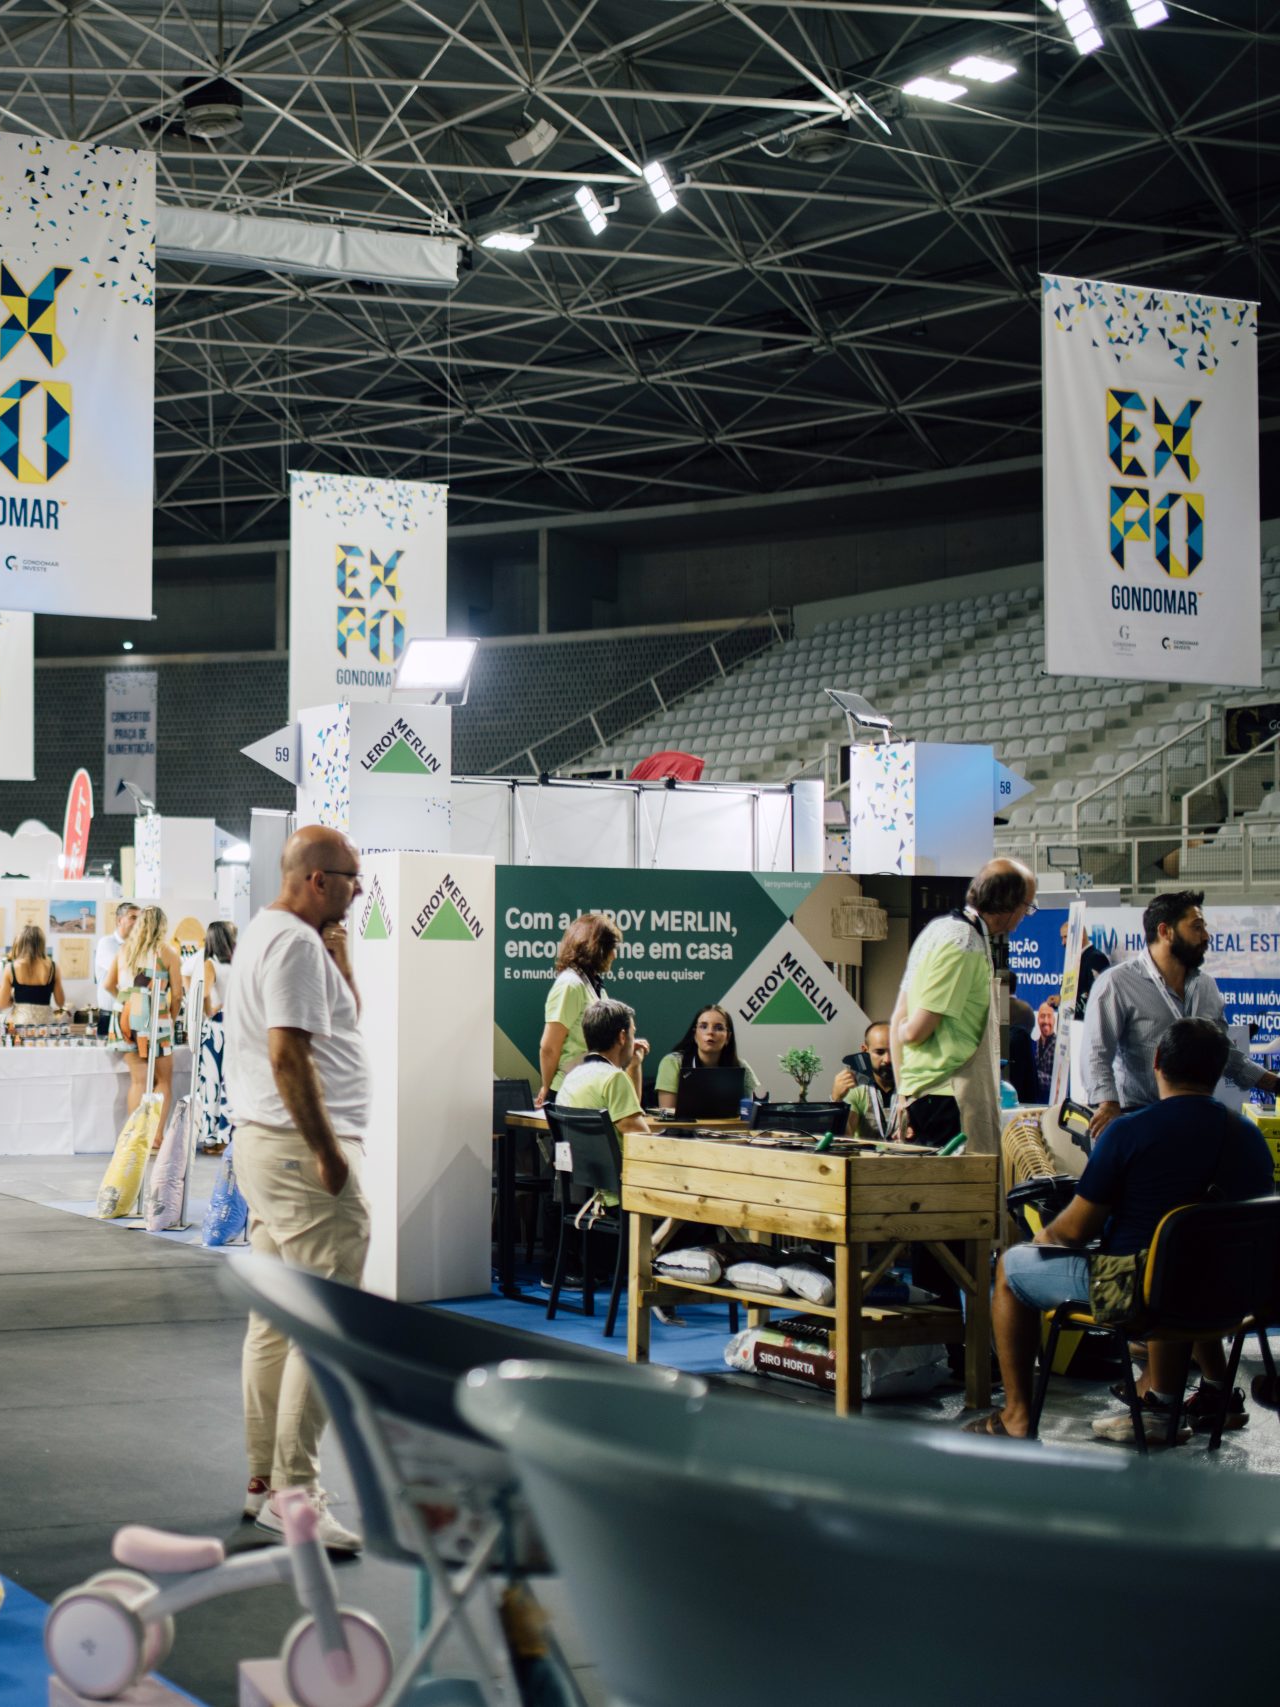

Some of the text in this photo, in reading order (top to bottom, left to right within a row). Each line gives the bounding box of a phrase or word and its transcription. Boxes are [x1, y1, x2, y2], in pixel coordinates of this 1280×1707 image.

[1105, 386, 1203, 483] EX
[1108, 484, 1205, 579] PO
[335, 543, 406, 603] EX
[1111, 585, 1198, 616] GONDOMAR
[336, 606, 406, 665] PO
[336, 668, 395, 687] GONDOMA
[111, 711, 151, 723] CONCERTOS
[114, 728, 147, 740] PRAÇA DE
[360, 717, 442, 774] LEROY MERLIN
[107, 742, 154, 756] ALIMENTAÇÃO
[275, 747, 290, 762] 59
[1000, 781, 1012, 795] 58
[358, 873, 393, 938] LEROY MERLIN
[410, 873, 485, 939] LEROY MERLIN
[505, 907, 553, 930] Com
[558, 913, 570, 930] a
[650, 910, 738, 937] MERLIN,
[649, 942, 682, 960] em
[686, 942, 734, 960] casa
[504, 967, 512, 979] E
[513, 970, 521, 979] o
[619, 967, 625, 980] é
[626, 970, 634, 980] o
[634, 970, 655, 983] que
[656, 970, 670, 980] eu
[671, 967, 706, 983] quiser
[739, 951, 839, 1022] LEROY MERLIN
[1238, 992, 1255, 1006] UM
[758, 1352, 781, 1366] SIRO
[783, 1357, 816, 1376] HORTA
